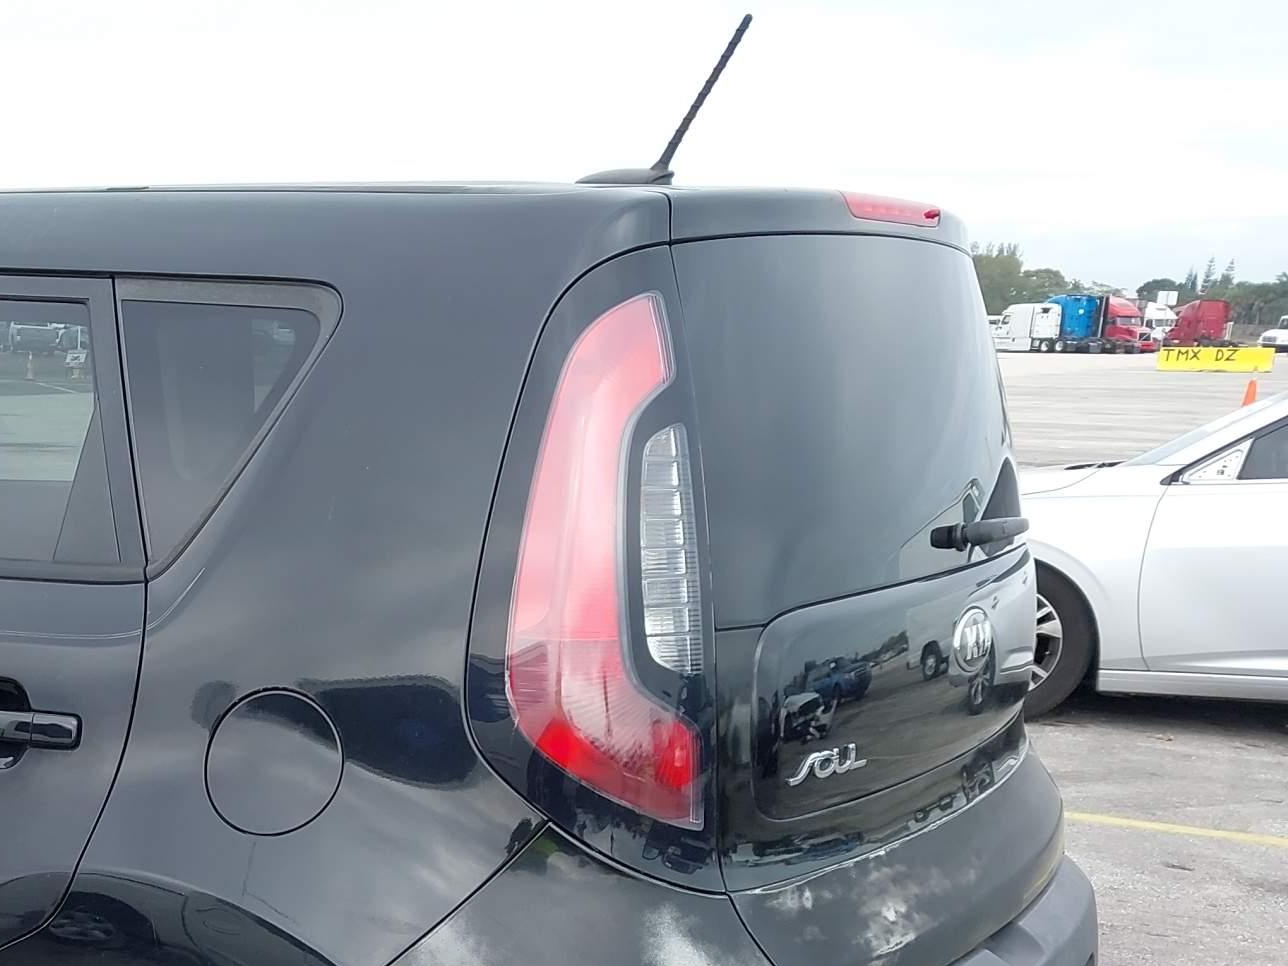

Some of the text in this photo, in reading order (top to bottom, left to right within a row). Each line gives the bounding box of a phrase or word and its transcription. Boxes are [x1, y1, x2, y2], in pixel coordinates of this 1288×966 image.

[1163, 349, 1240, 362] TMX DZ
[784, 743, 868, 787] SOUL
